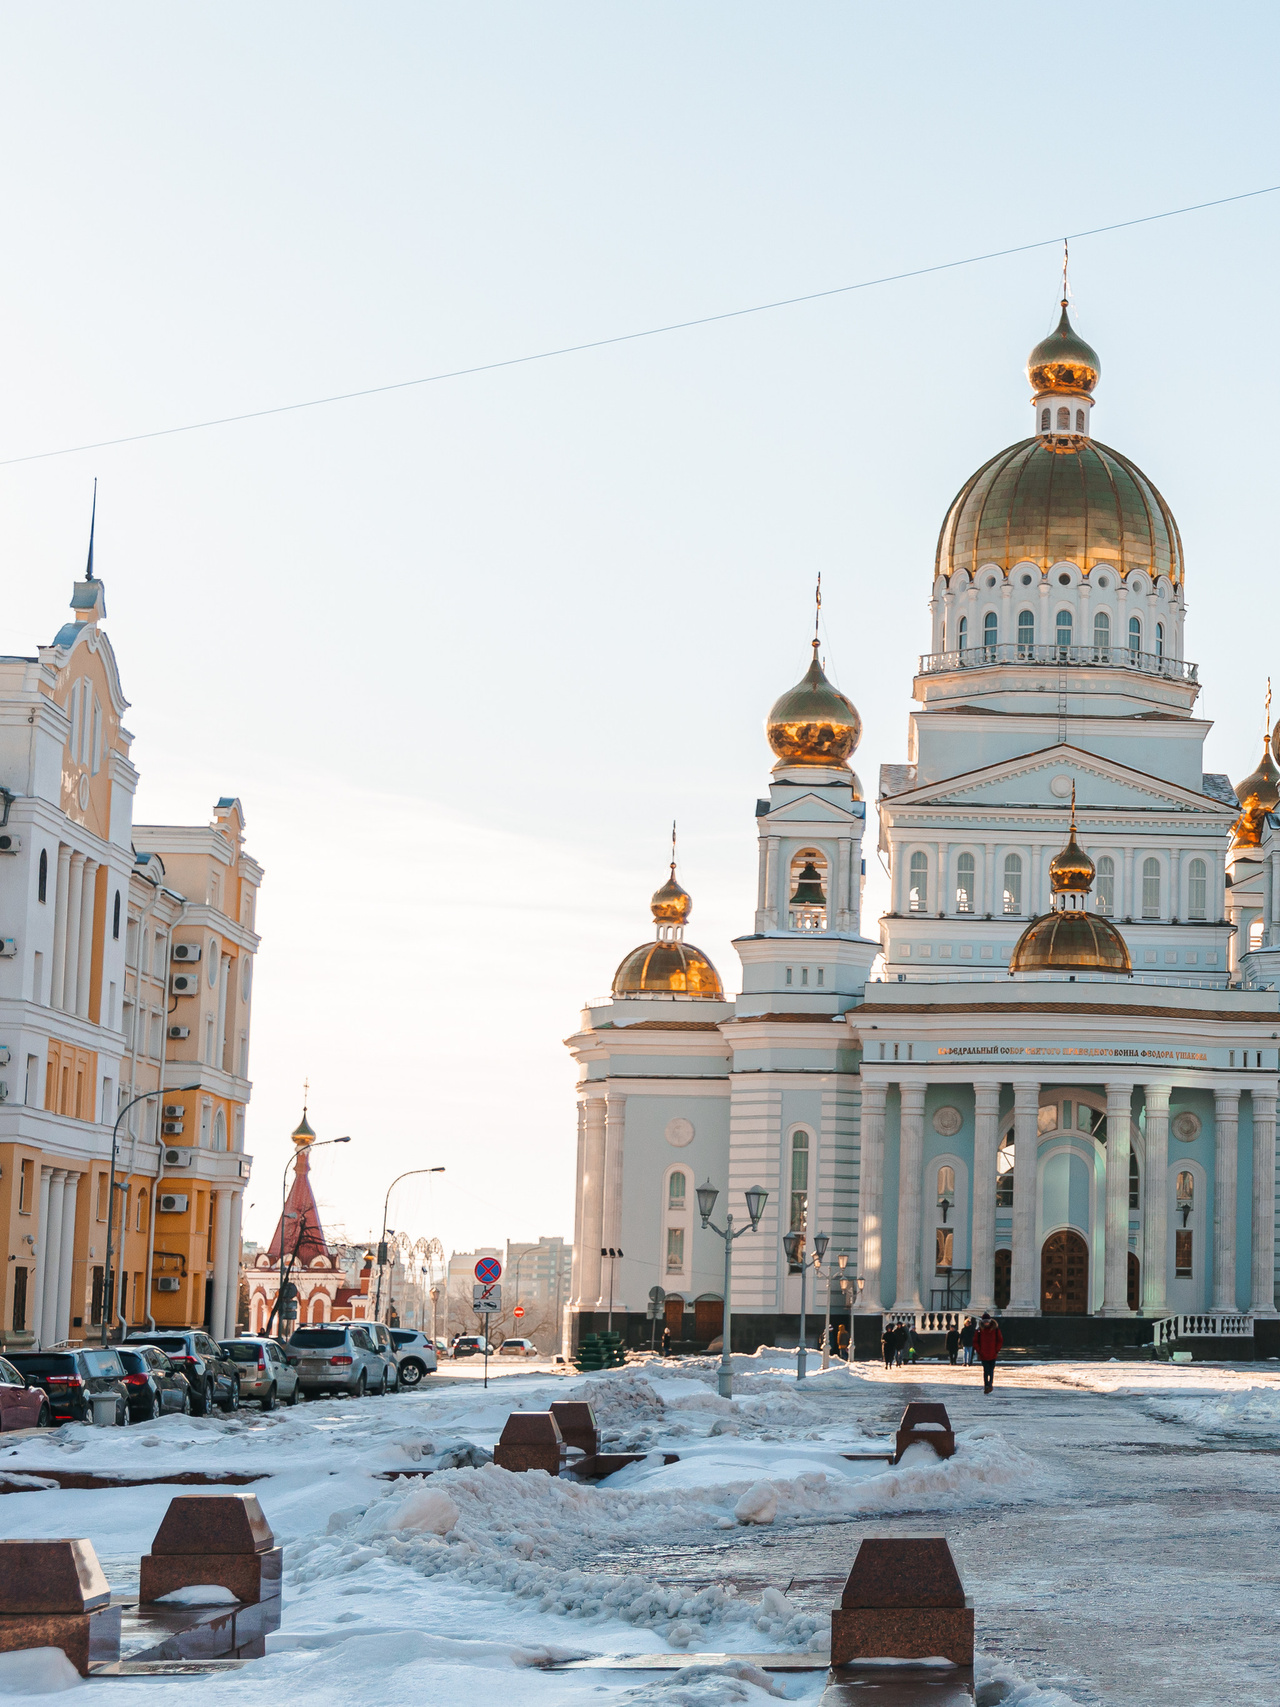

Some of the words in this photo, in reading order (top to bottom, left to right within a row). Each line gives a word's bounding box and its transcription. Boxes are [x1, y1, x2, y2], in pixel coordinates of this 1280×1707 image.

[938, 1046, 998, 1056] КАФЕДРАЛЬНЫЙ
[1000, 1047, 1024, 1055] СОБОР
[1025, 1047, 1061, 1055] СВЯТОГО
[1062, 1048, 1113, 1057] ПРАВЕДНОГО
[1141, 1049, 1174, 1059] ФЕОДОРА
[1176, 1051, 1207, 1061] УШАКОВА
